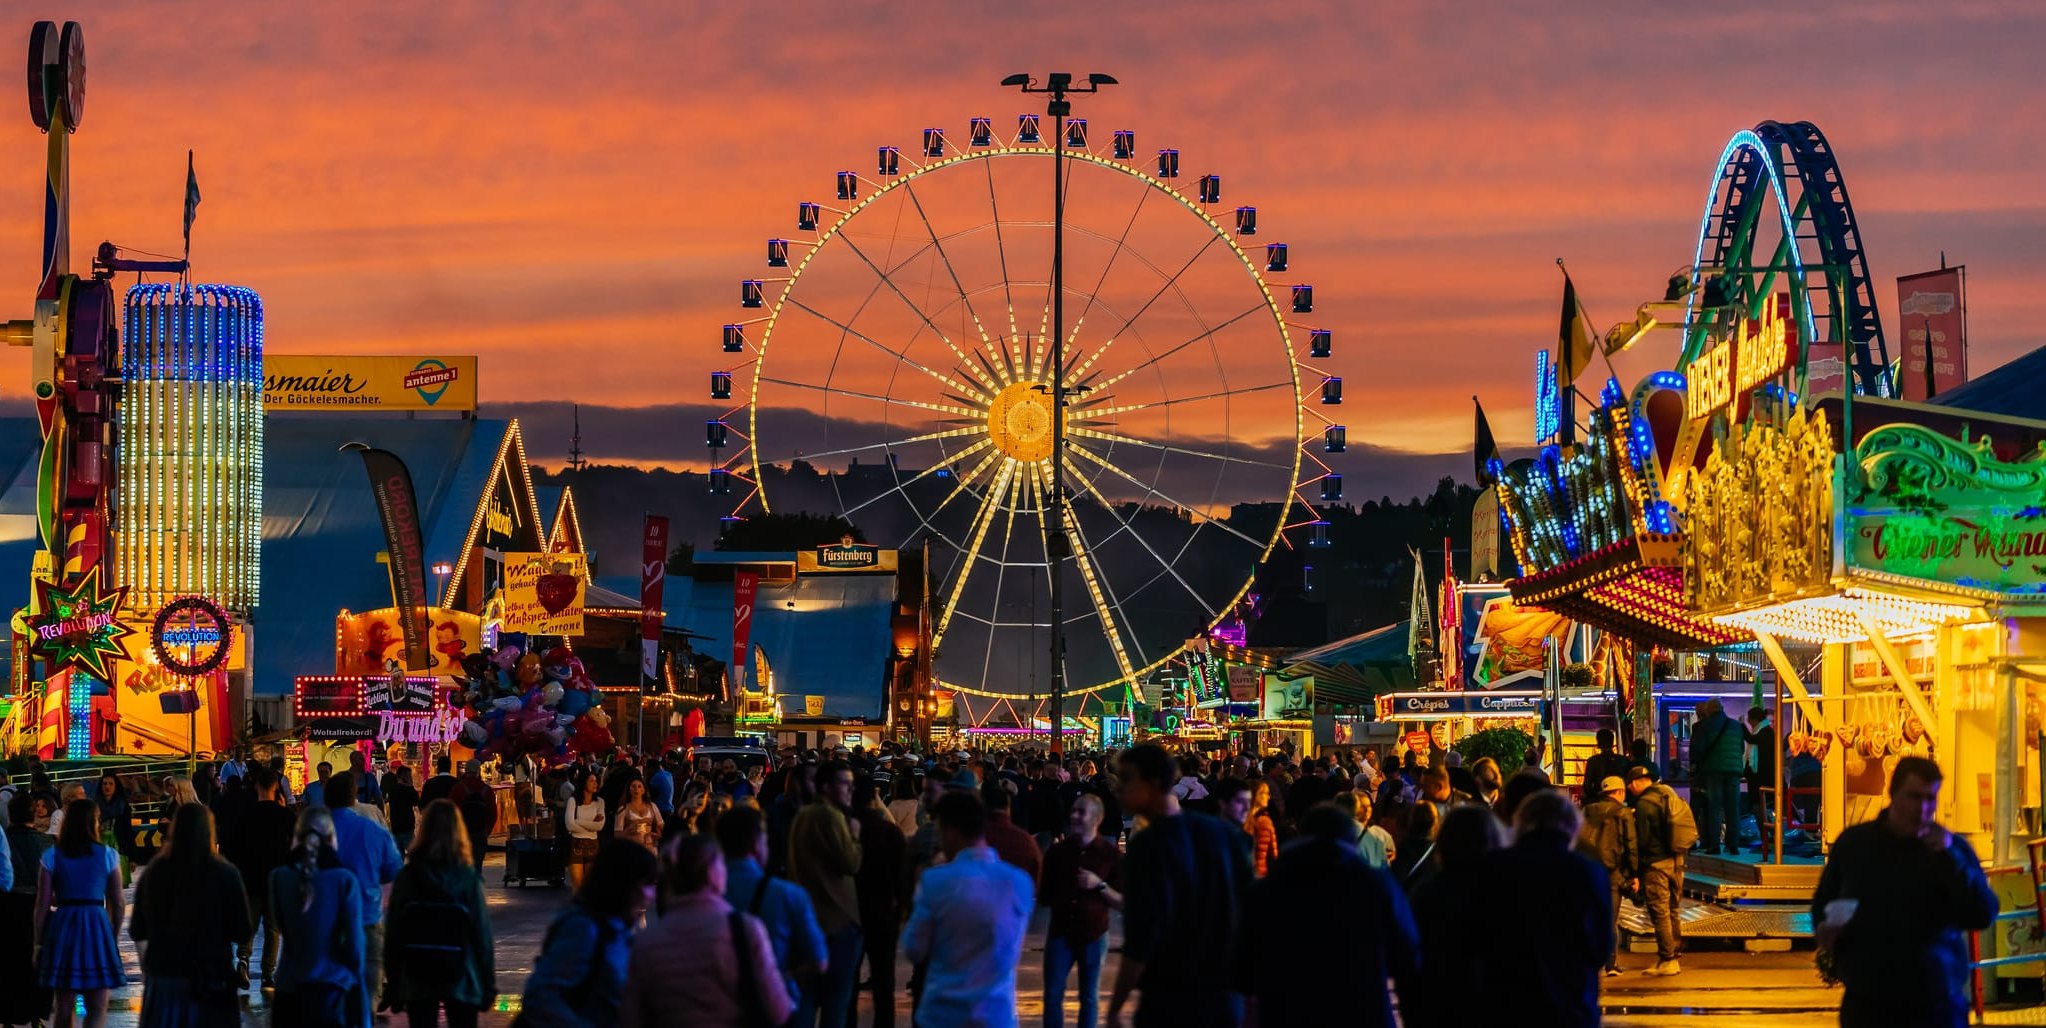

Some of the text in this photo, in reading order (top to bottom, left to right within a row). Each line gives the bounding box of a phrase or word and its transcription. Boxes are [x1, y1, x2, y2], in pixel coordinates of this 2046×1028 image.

[262, 369, 368, 394] smaier
[406, 369, 456, 387] antenne 1
[264, 393, 382, 405] Der Göckelesmacher.
[650, 526, 660, 537] 10
[823, 548, 873, 563] Fürstenberg
[37, 611, 113, 640] REVOLUTION
[538, 621, 581, 634] Torrone
[162, 631, 220, 642] REVOLUTION
[1407, 697, 1450, 711] Crêpes
[313, 728, 373, 737] Weltallrekord!
[376, 709, 405, 743] Du
[408, 708, 442, 743] und
